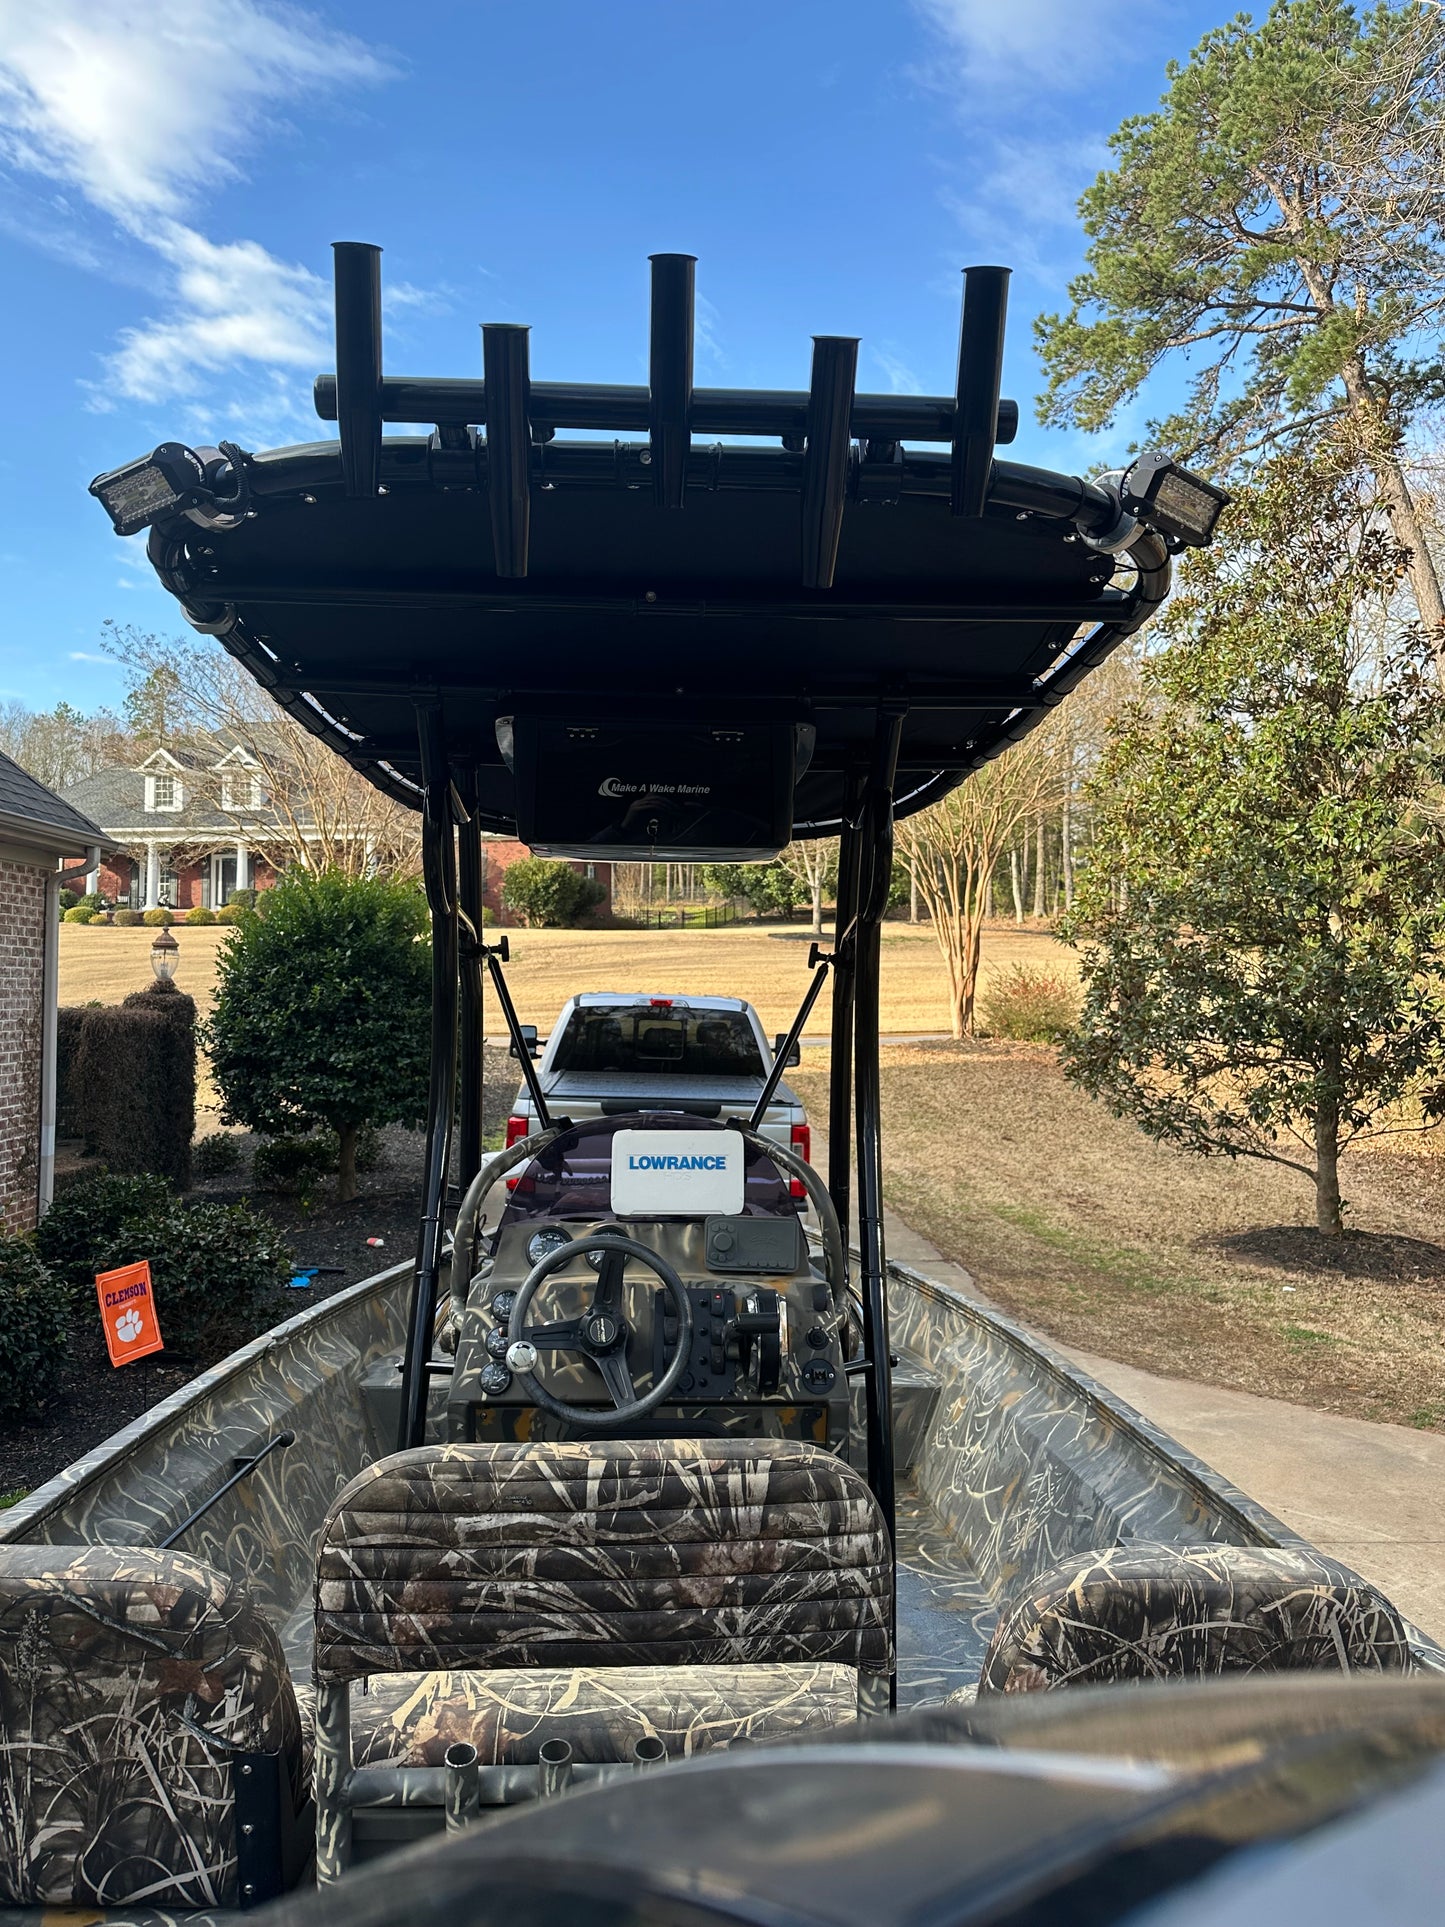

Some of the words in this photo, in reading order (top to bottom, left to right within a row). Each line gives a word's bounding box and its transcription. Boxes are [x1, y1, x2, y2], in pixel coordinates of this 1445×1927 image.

[611, 783, 637, 792] Make
[638, 784, 647, 793] A
[649, 784, 675, 793] Wake
[677, 784, 711, 794] Marine
[629, 1156, 726, 1170] LOWRANCE
[105, 1282, 147, 1308] CLEMSON
